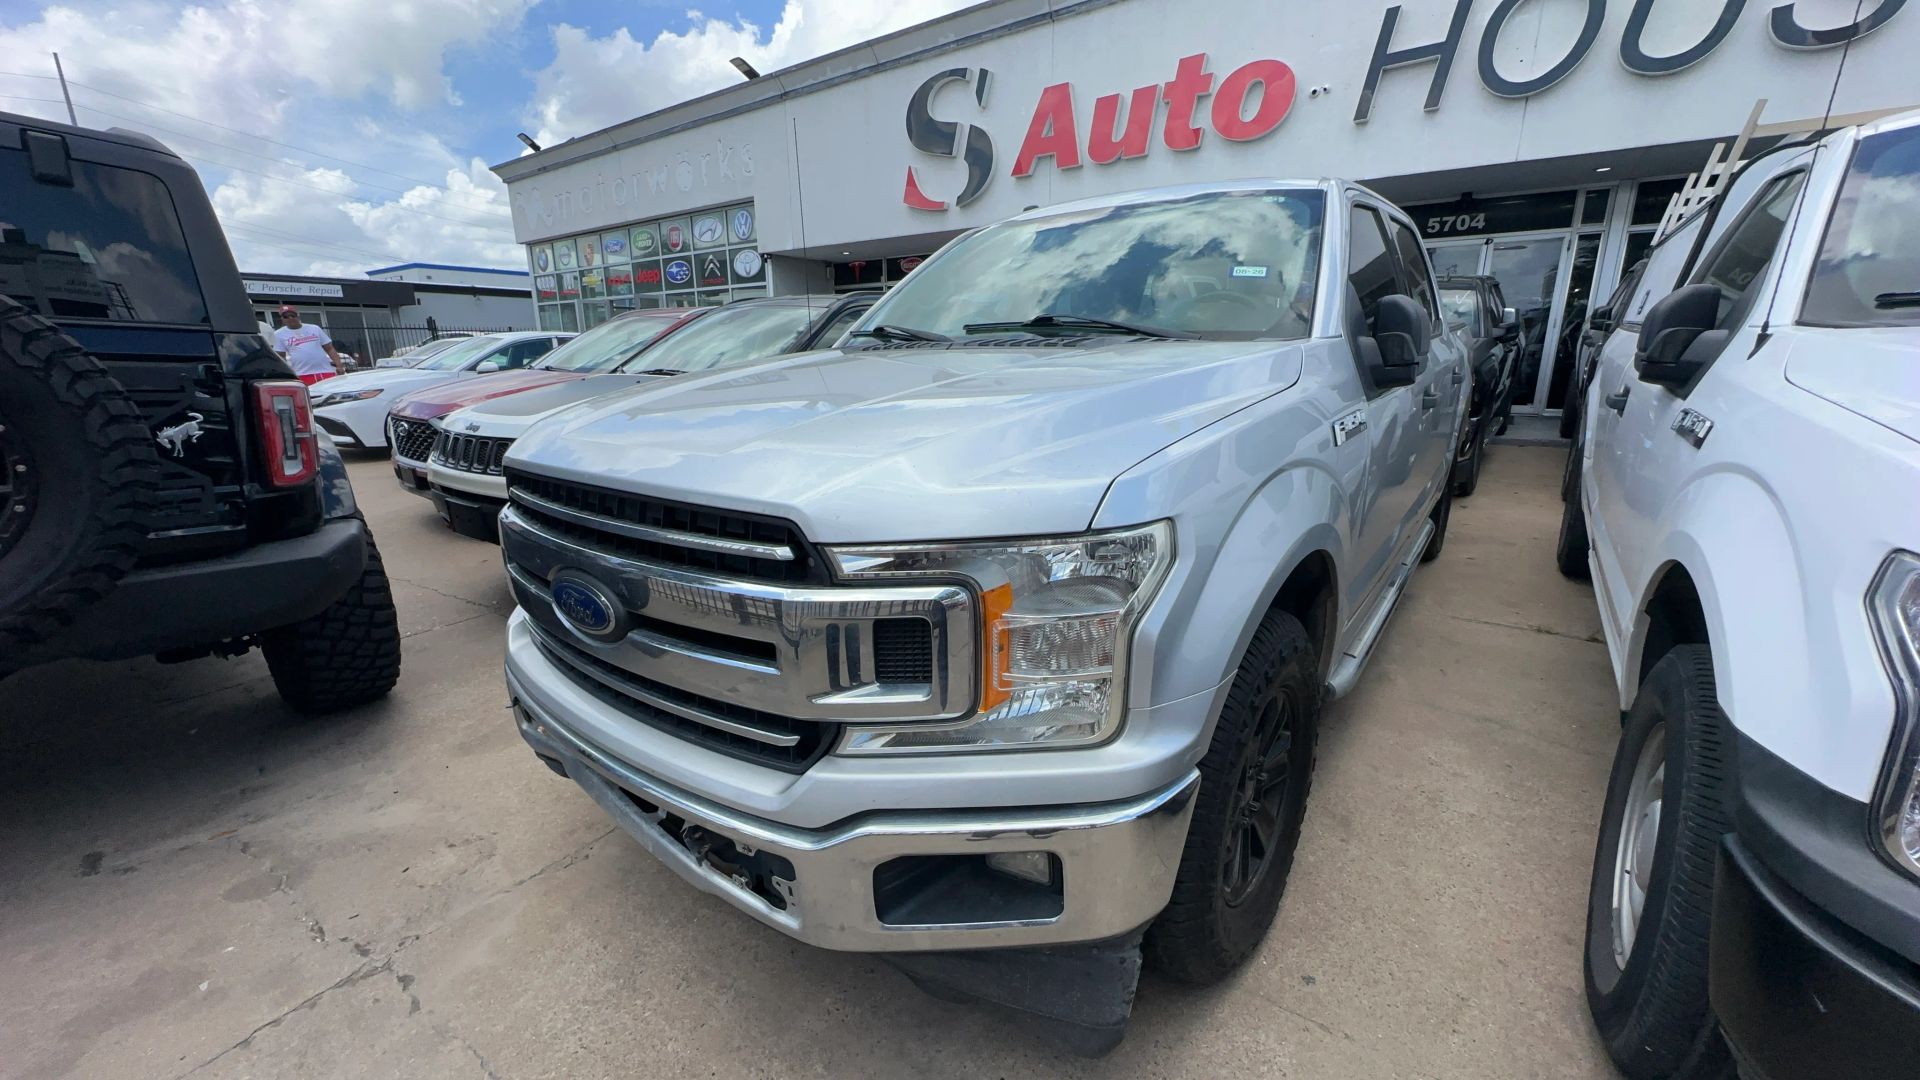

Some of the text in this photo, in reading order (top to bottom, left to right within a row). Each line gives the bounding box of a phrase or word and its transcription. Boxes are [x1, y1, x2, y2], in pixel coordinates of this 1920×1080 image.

[1010, 52, 1297, 177] Auto
[1427, 212, 1486, 233] 5704
[262, 283, 302, 293] Porsche
[308, 285, 341, 296] Repair
[561, 588, 595, 625] Ford
